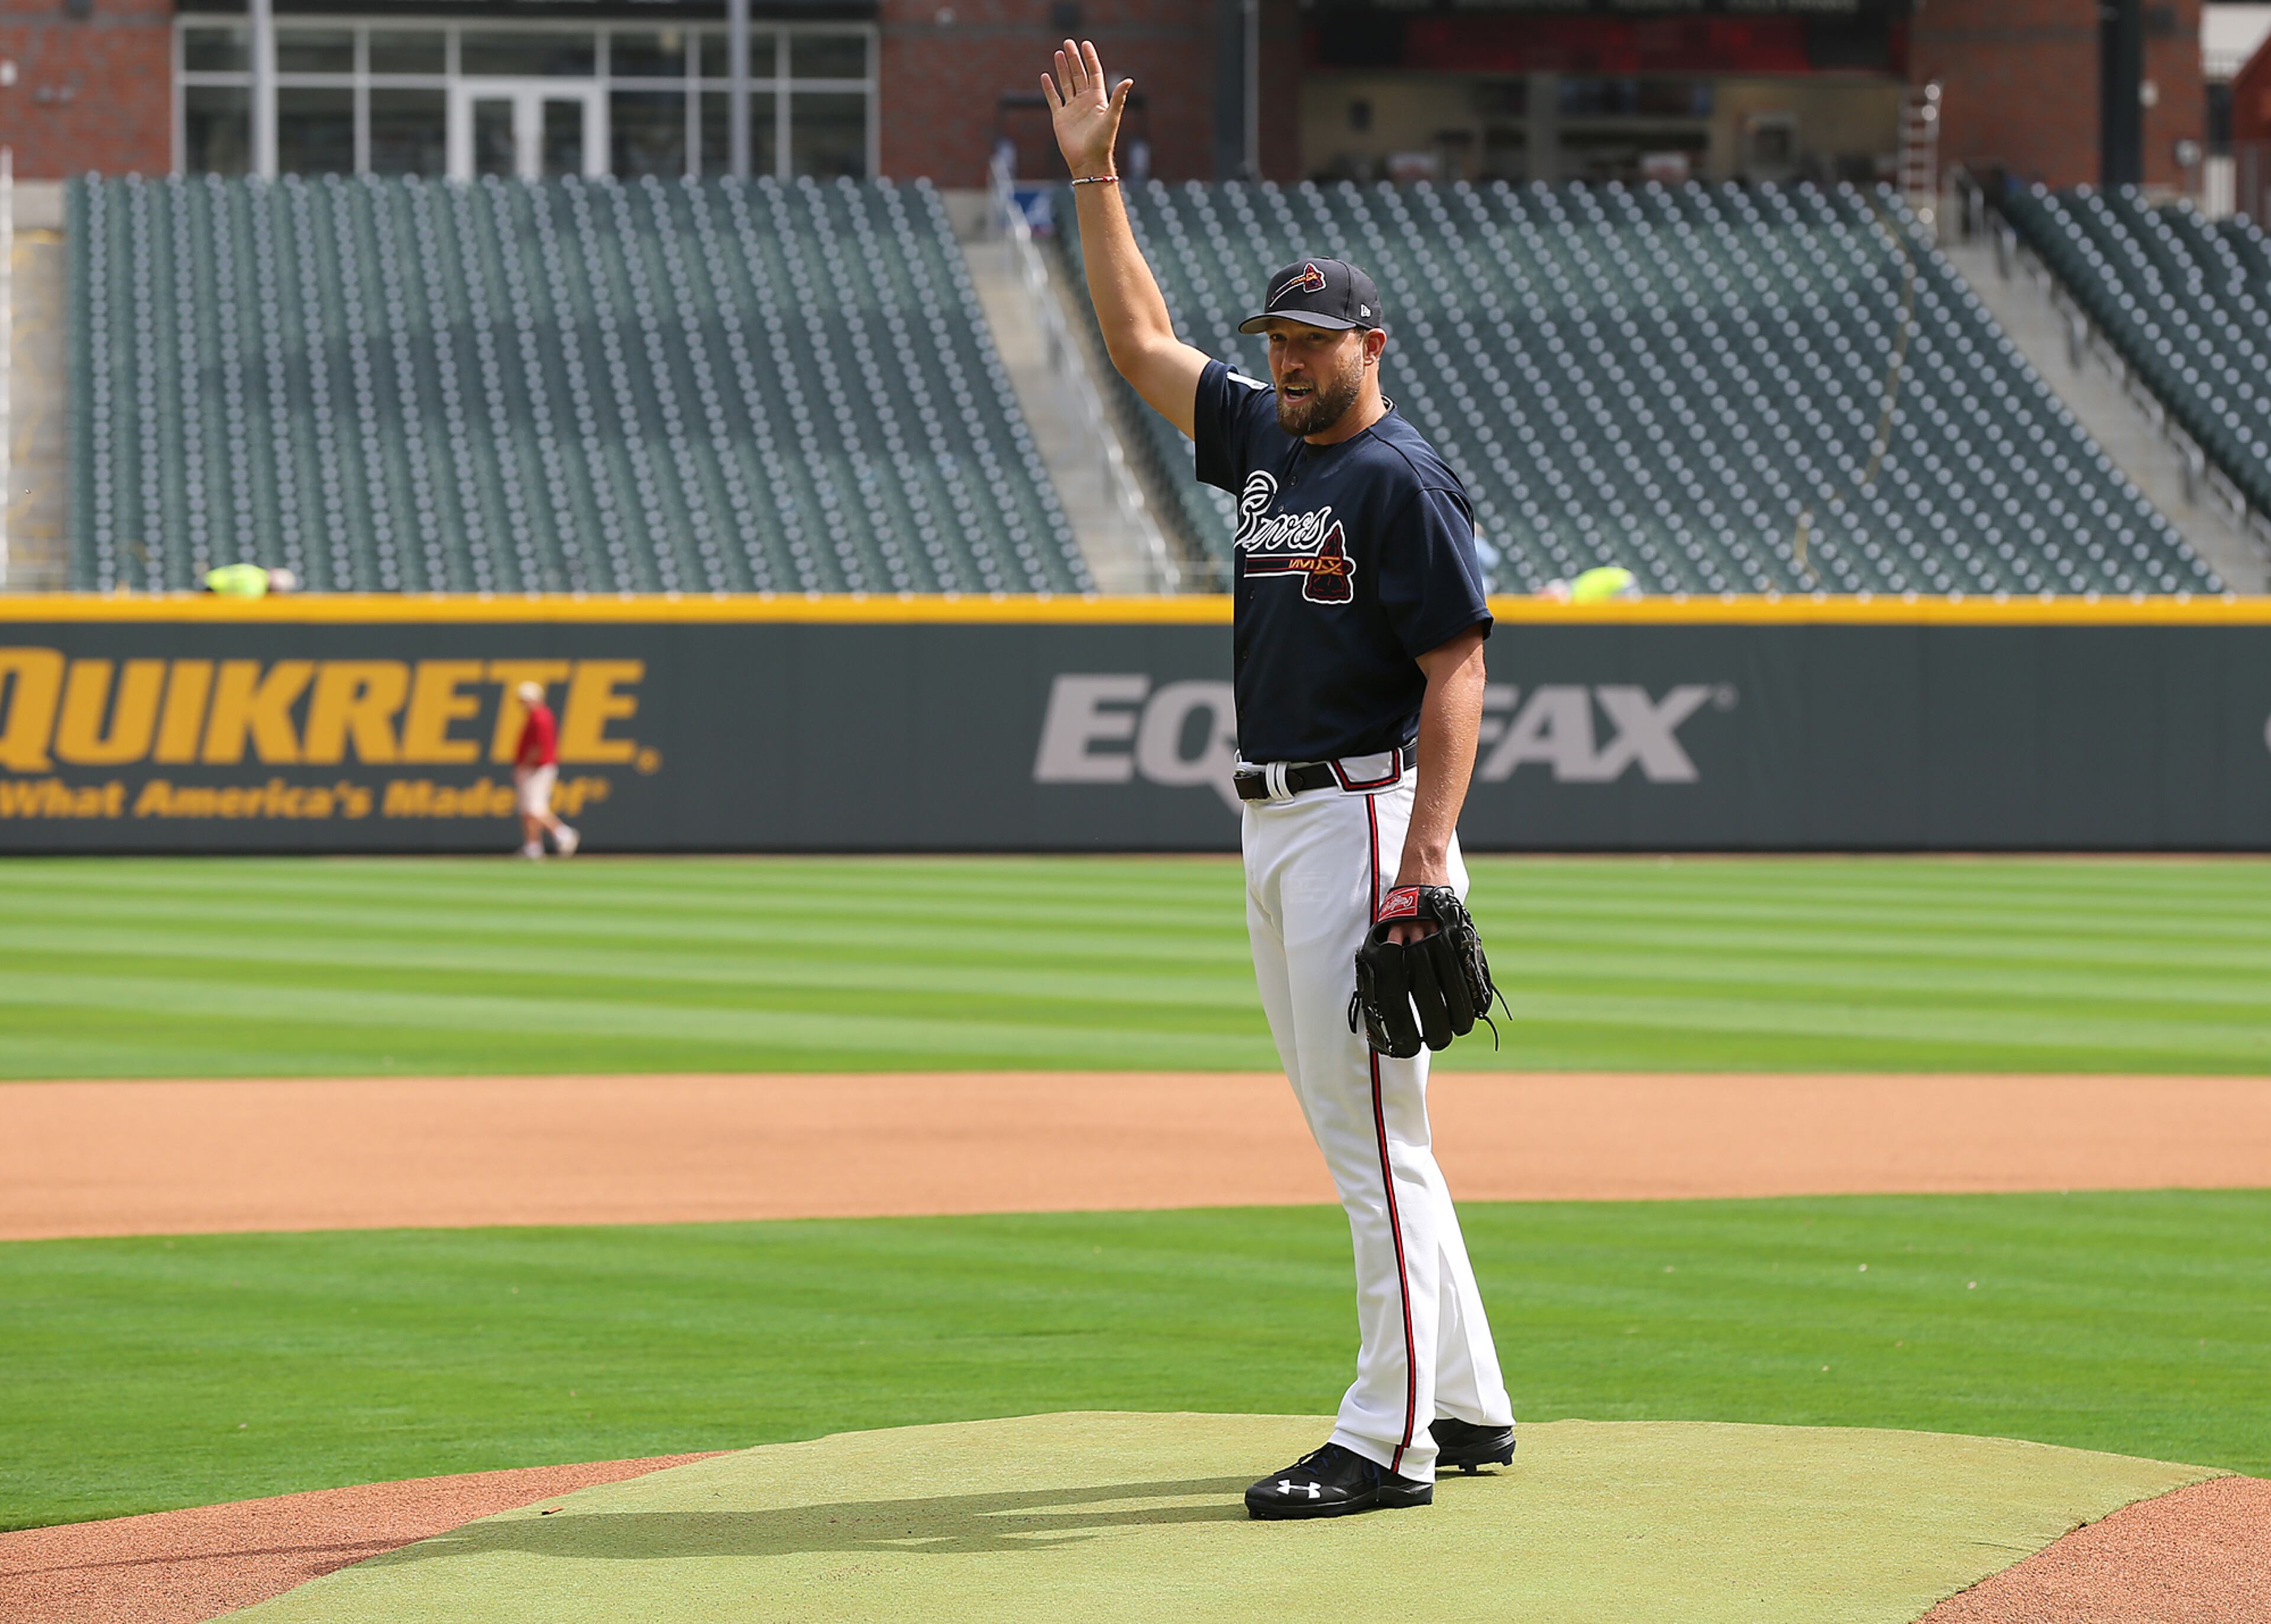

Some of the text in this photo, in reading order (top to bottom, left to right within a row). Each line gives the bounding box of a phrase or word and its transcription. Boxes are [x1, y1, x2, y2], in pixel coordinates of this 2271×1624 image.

[0, 647, 642, 772] QUIKRETE
[1034, 675, 1700, 816] EQAX
[0, 778, 125, 819] What
[134, 777, 370, 819] America's
[384, 778, 516, 819] Made
